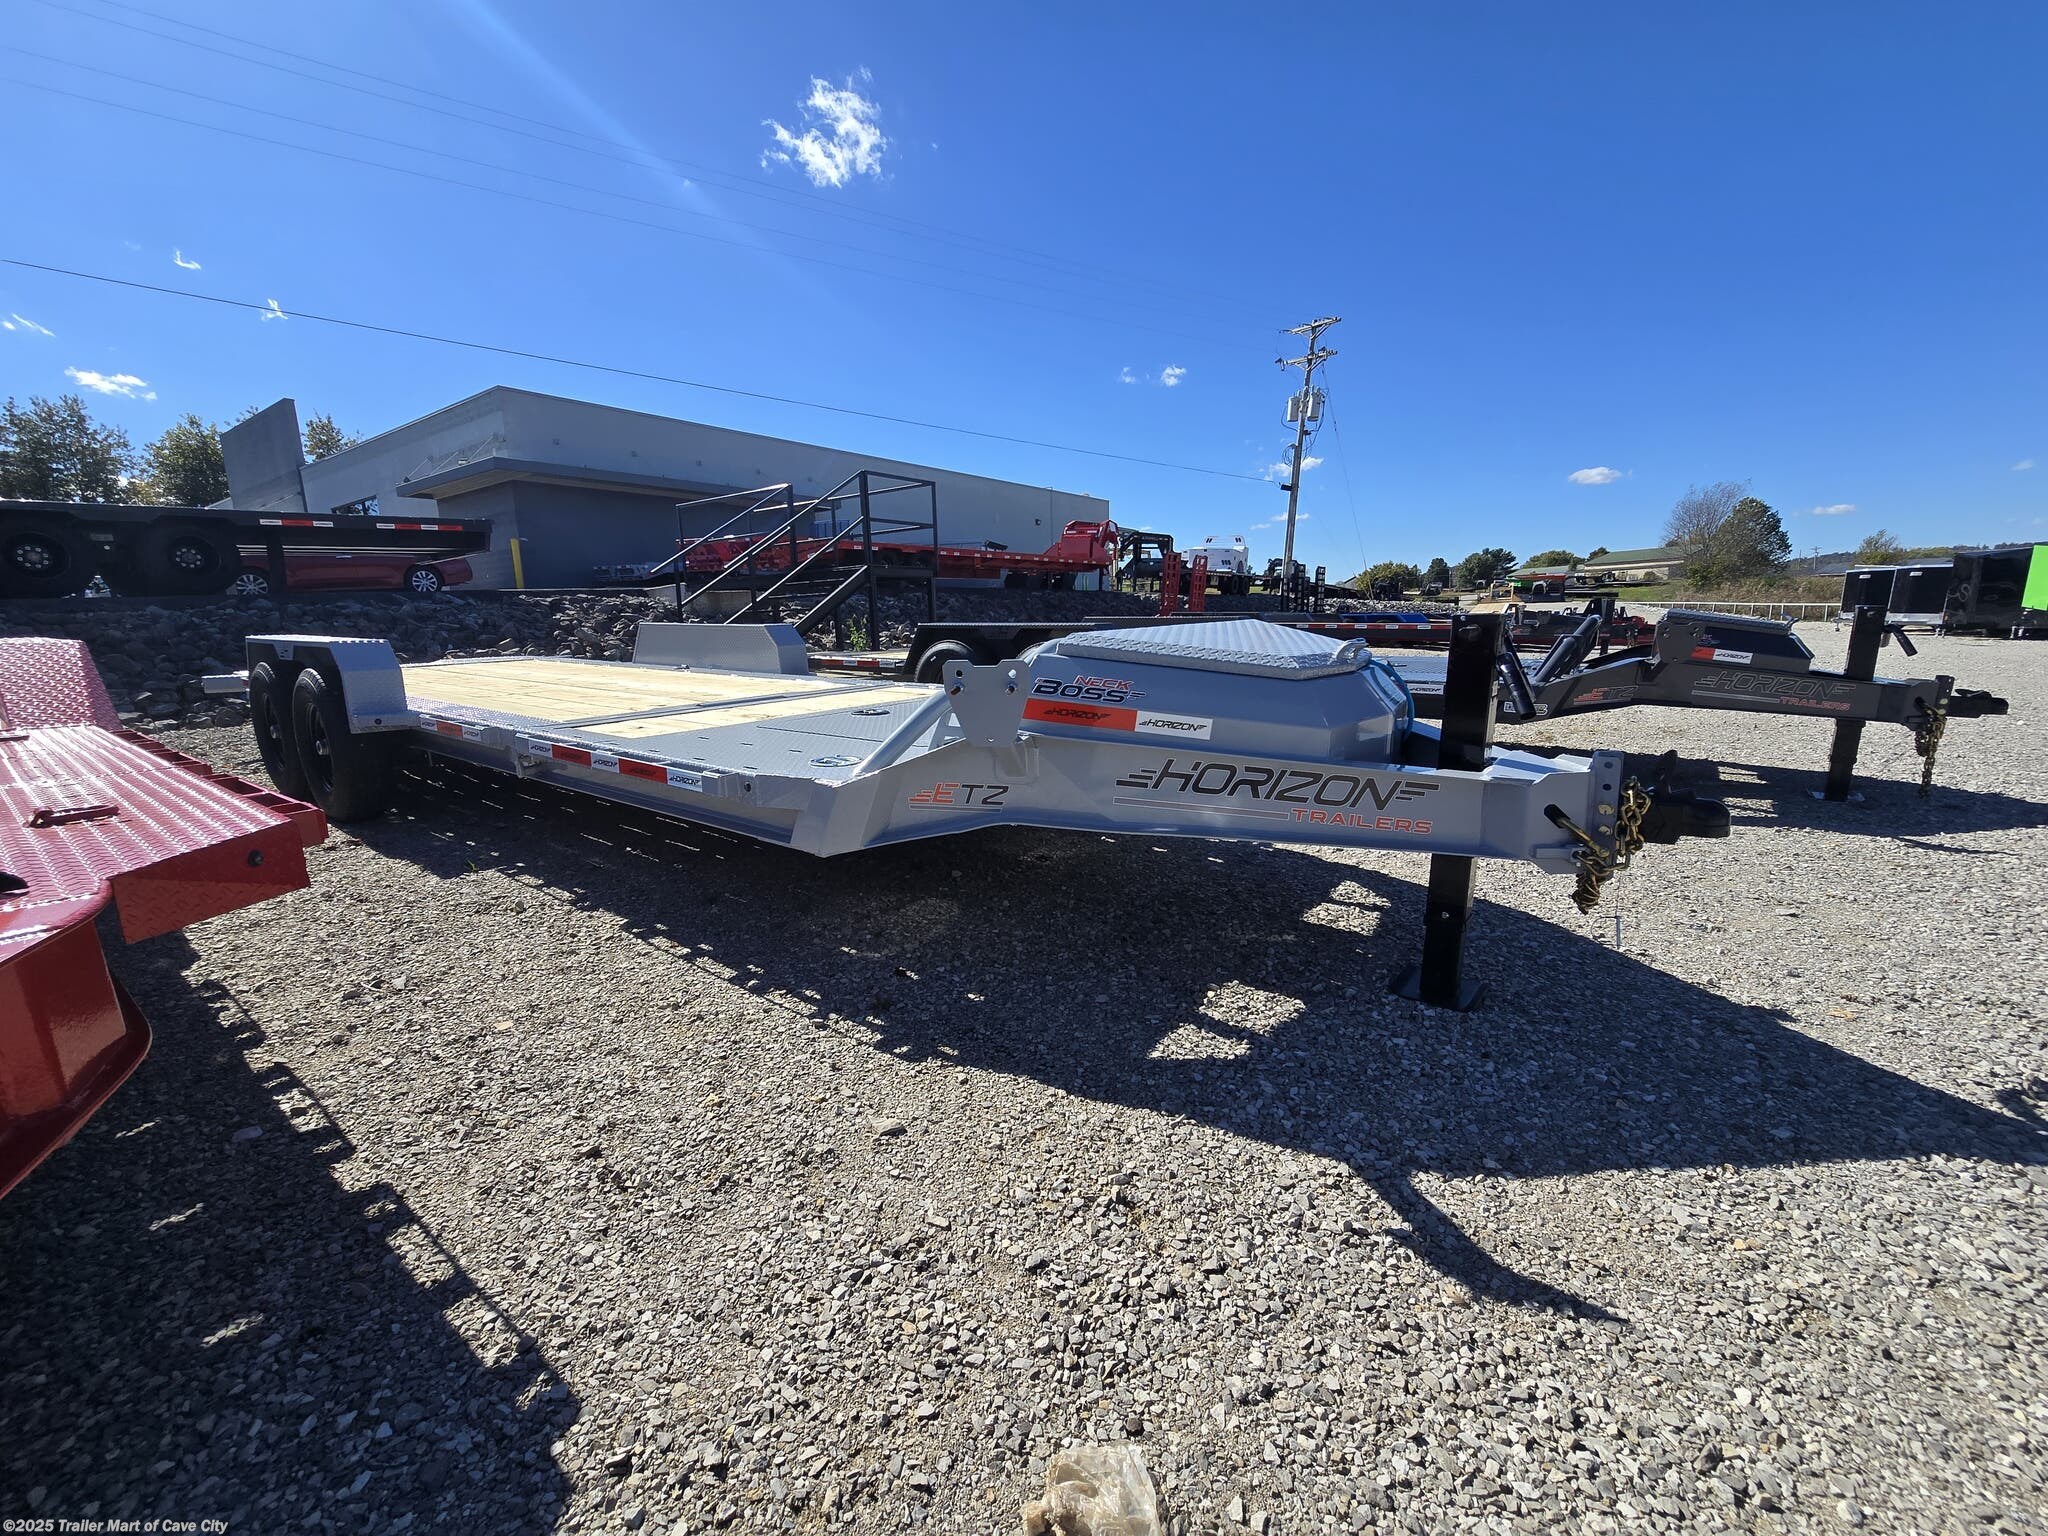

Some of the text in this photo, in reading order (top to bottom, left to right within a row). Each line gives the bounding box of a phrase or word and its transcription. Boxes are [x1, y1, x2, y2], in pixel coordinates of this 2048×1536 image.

[1032, 677, 1128, 703] BOSS
[1074, 675, 1134, 690] NECK
[1711, 671, 1835, 698] HORIZON
[1780, 696, 1851, 711] TRAILERS
[1051, 707, 1105, 720] HORIZON
[1146, 718, 1201, 732] HORIZON
[672, 775, 698, 786] HORIZON
[1152, 759, 1403, 811] HORIZON
[1291, 808, 1433, 835] TRAILERS
